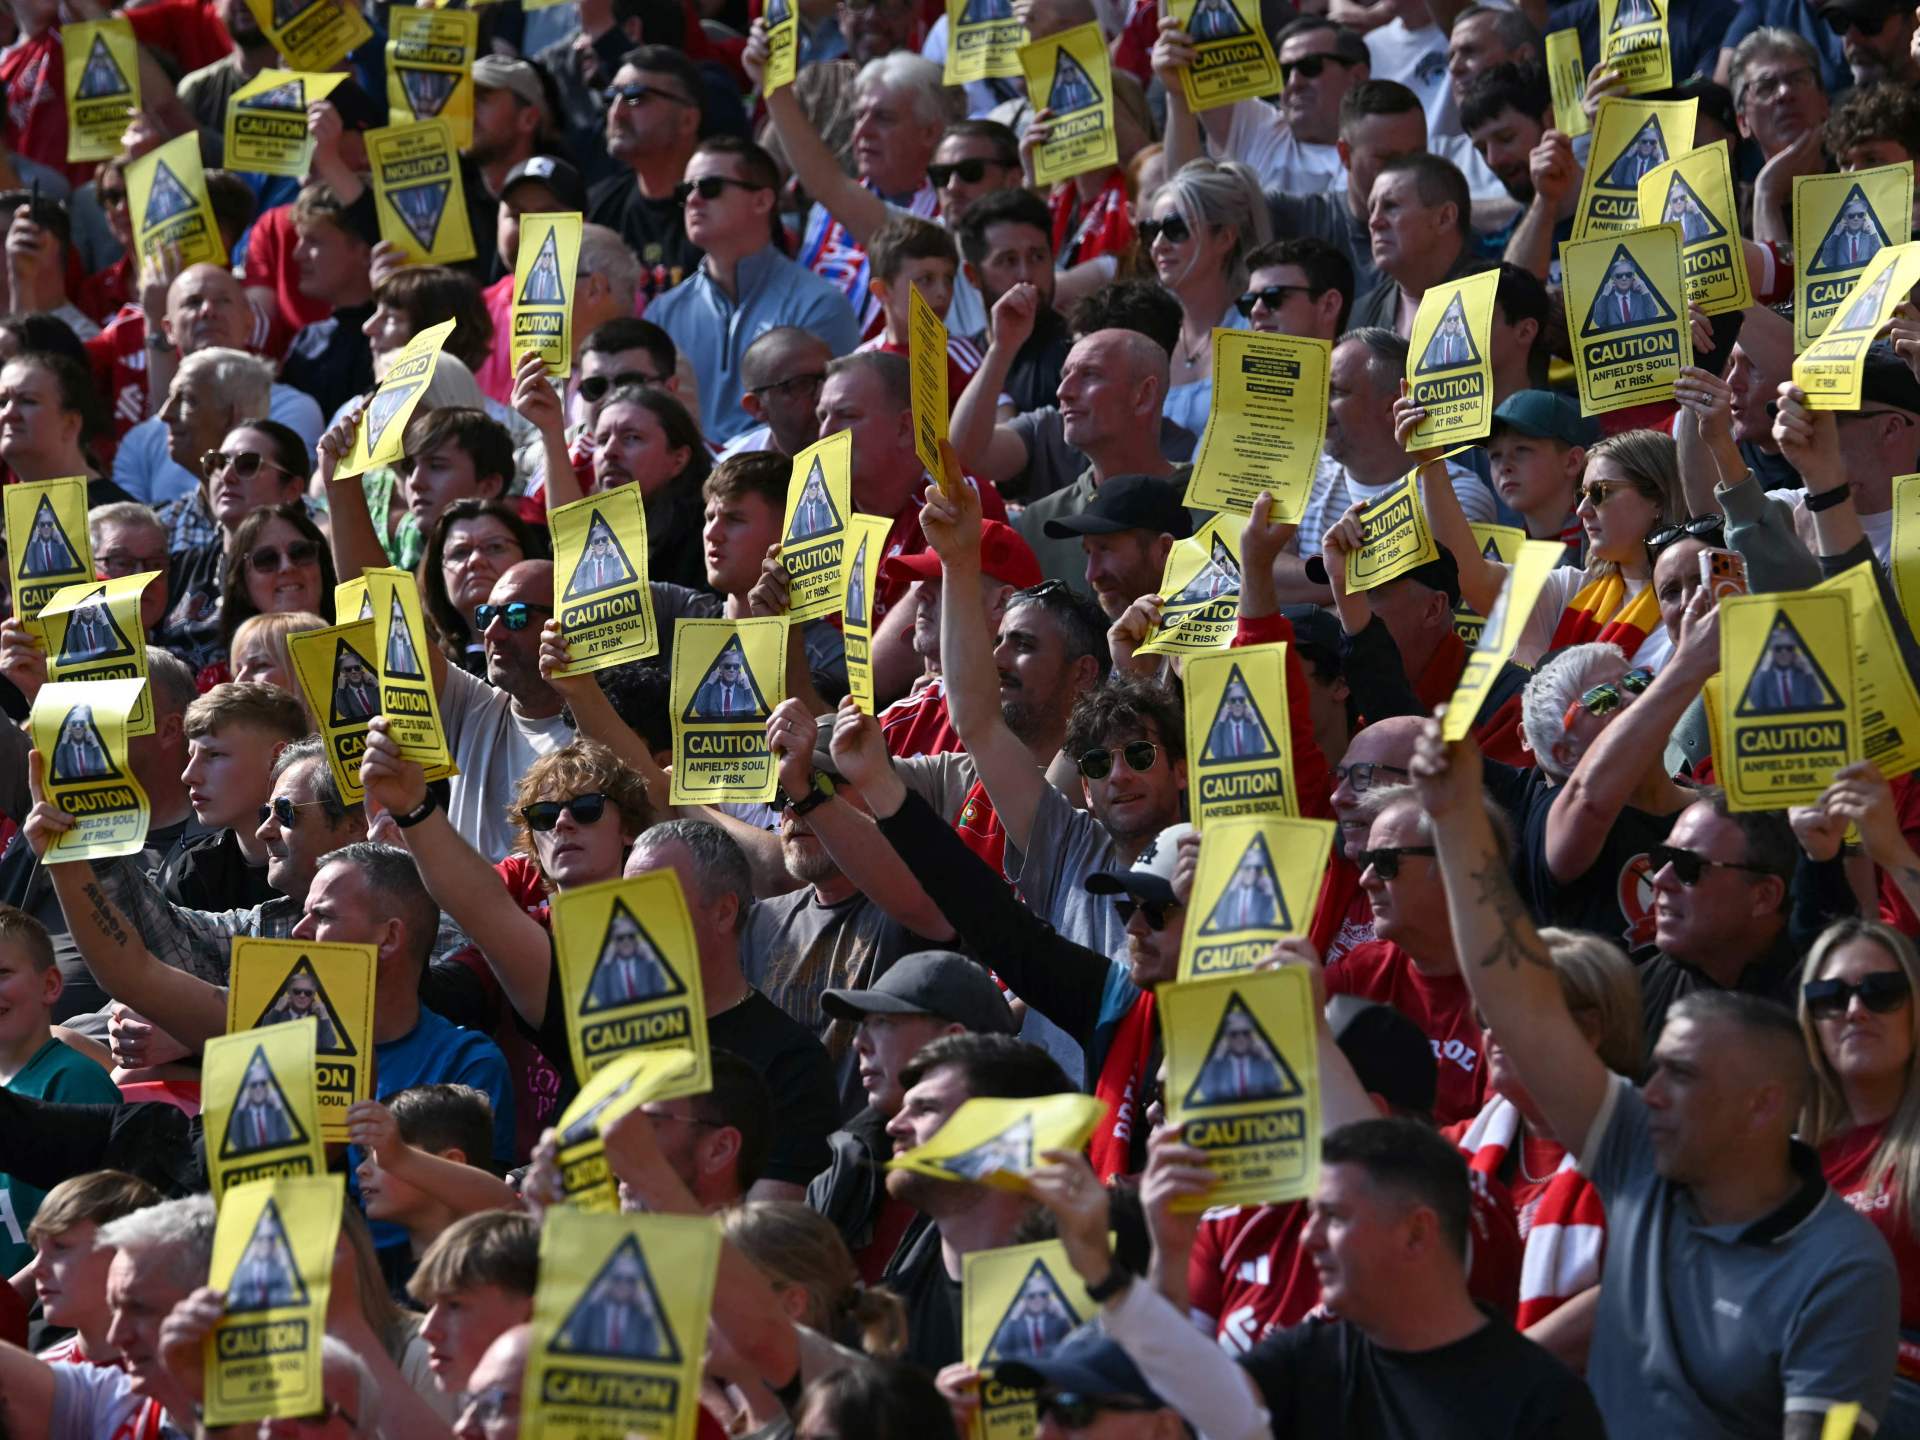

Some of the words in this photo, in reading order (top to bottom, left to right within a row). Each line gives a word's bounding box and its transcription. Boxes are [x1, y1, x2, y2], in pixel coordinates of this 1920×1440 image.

[960, 27, 1021, 51] CAUTION
[1192, 44, 1260, 70] CAUTION
[238, 119, 304, 137] CAUTION
[1052, 115, 1101, 139] AUTION
[385, 157, 448, 180] CAUTION
[1683, 248, 1726, 275] TION
[1701, 271, 1730, 286] SOUL
[517, 315, 561, 332] CAUTION
[1588, 333, 1674, 365] CAUTION
[1592, 364, 1645, 384] ANFIELD'S
[1645, 356, 1676, 374] SOUL
[1614, 379, 1627, 390] AT
[1629, 373, 1655, 389] RISK
[1417, 376, 1481, 402] CAUTION
[1425, 403, 1458, 419] NFIELD'S
[1459, 399, 1481, 412] SOUL
[1435, 419, 1445, 429] AT
[1446, 415, 1464, 426] RISK
[1362, 500, 1410, 541] CAUTION
[1360, 533, 1396, 560] ANFIELD'S
[1395, 525, 1413, 542] SOUL
[786, 544, 842, 575] CAUTION
[1377, 555, 1386, 566] AT
[1387, 546, 1402, 561] RISK
[790, 572, 823, 593] ANFIELD'S
[824, 567, 842, 583] SOUL
[805, 589, 814, 601] AT
[814, 585, 831, 598] RISK
[565, 594, 636, 628] CAUTION
[567, 624, 614, 646] ANFIELD'S
[615, 619, 641, 634] SOUL
[1175, 633, 1191, 641] AT
[1192, 634, 1218, 643] RISK
[588, 643, 601, 654] AT
[602, 637, 624, 650] RISK
[386, 689, 428, 712] CAUTION
[416, 720, 434, 731] SOUL
[401, 732, 410, 742] AT
[409, 732, 425, 743] RISK
[688, 735, 768, 754] CAUTION
[1741, 726, 1841, 752] CAUTION
[688, 761, 740, 773] ANFIELD'S
[741, 760, 766, 771] SOUL
[1744, 757, 1807, 773] ANFIELD'S
[1808, 755, 1842, 768] SOUL
[708, 774, 720, 785] AT
[722, 774, 745, 785] RISK
[1202, 772, 1279, 799] CAUTION
[1771, 774, 1785, 786] AT
[1788, 773, 1818, 785] RISK
[62, 789, 131, 814] CAUTION
[1205, 802, 1253, 818] ANFIELD'S
[1253, 800, 1282, 813] SOUL
[112, 813, 137, 827] SOUL
[80, 830, 93, 841] AT
[93, 827, 116, 840] RISK
[586, 1012, 684, 1051] CAUTION
[1187, 1113, 1299, 1146] CAUTION
[220, 1326, 304, 1356] CAUTION
[550, 1372, 670, 1408] CAUTION
